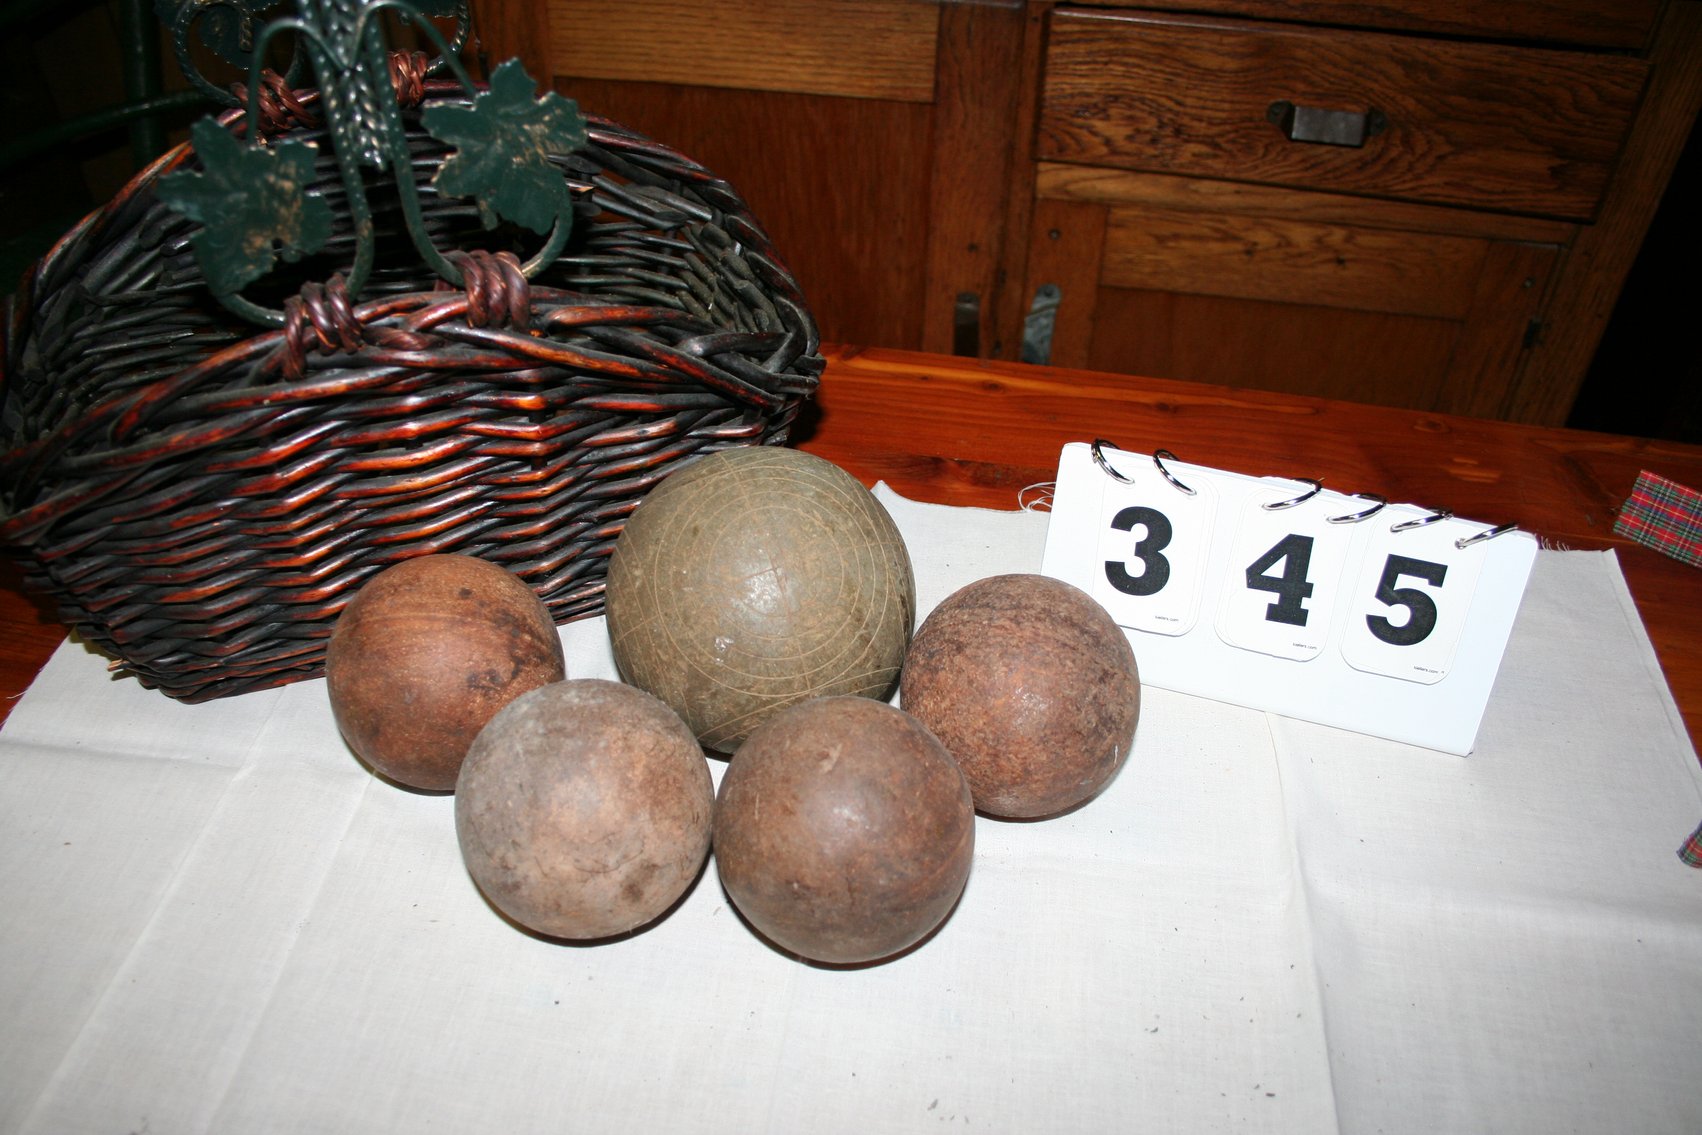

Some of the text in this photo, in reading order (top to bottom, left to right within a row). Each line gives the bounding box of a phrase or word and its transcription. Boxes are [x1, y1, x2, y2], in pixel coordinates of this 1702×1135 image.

[1104, 506, 1448, 646] 3 4 5
